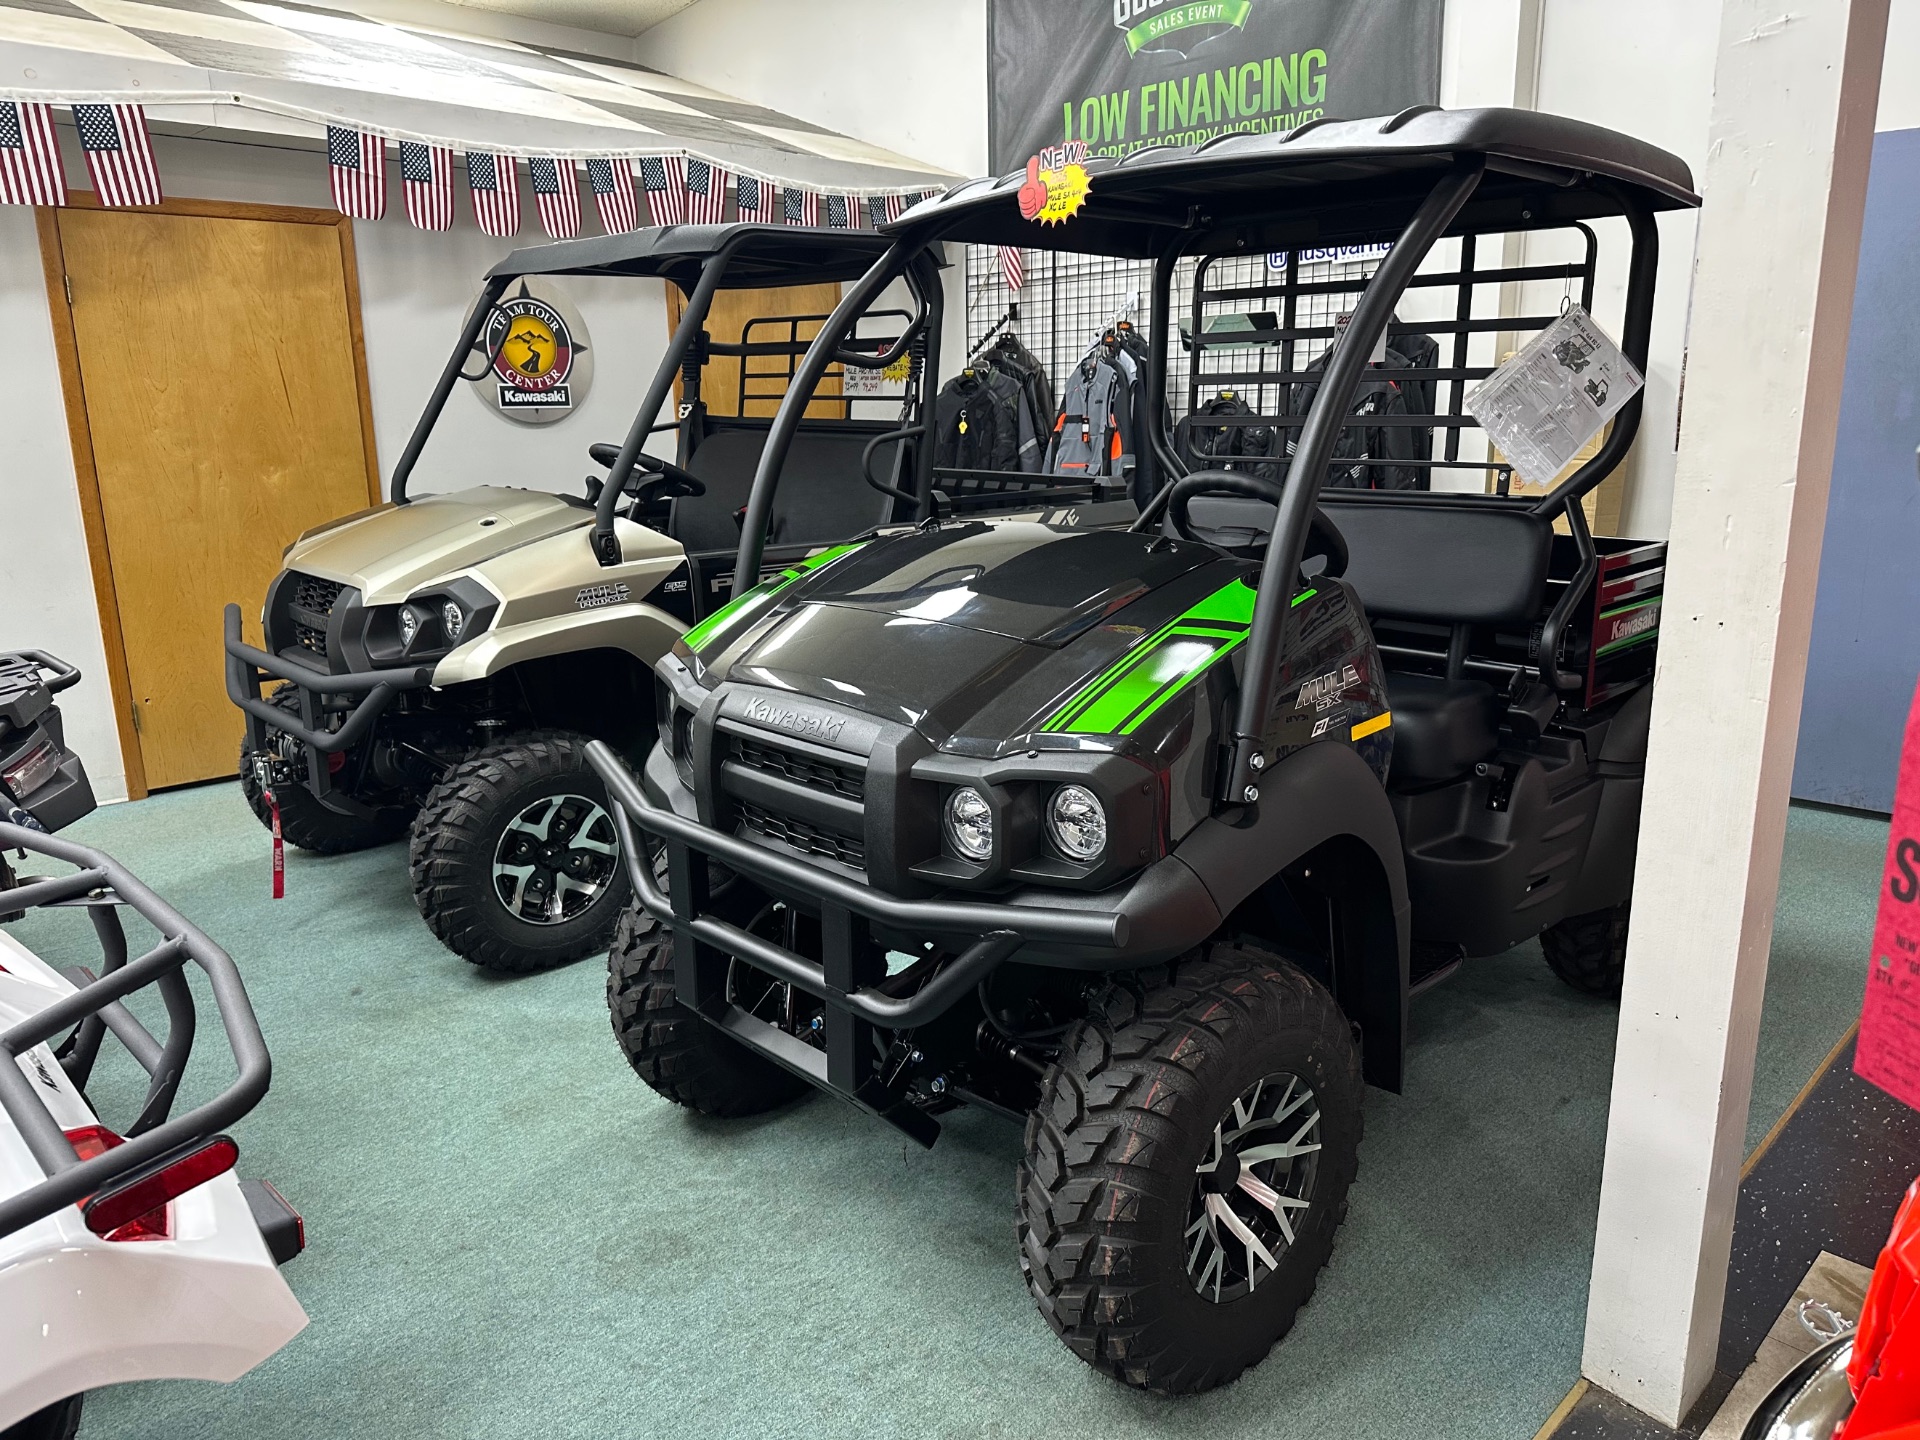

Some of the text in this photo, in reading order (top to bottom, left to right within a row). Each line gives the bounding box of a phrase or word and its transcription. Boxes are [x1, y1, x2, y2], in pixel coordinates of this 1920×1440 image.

[1150, 4, 1224, 35] SALES EVENT
[1063, 48, 1328, 146] LOW FINANCING
[1041, 141, 1086, 171] NEW!
[1058, 201, 1067, 211] LE
[528, 304, 559, 333] TOUR
[505, 369, 561, 389] CENTER
[503, 389, 566, 403] Kawasaki
[576, 581, 632, 604] MULE
[1610, 607, 1658, 641] Kawasaki
[1294, 664, 1362, 710] MULE
[1315, 691, 1343, 713] SX
[743, 696, 847, 743] Kawasaki
[274, 847, 283, 872] WARN
